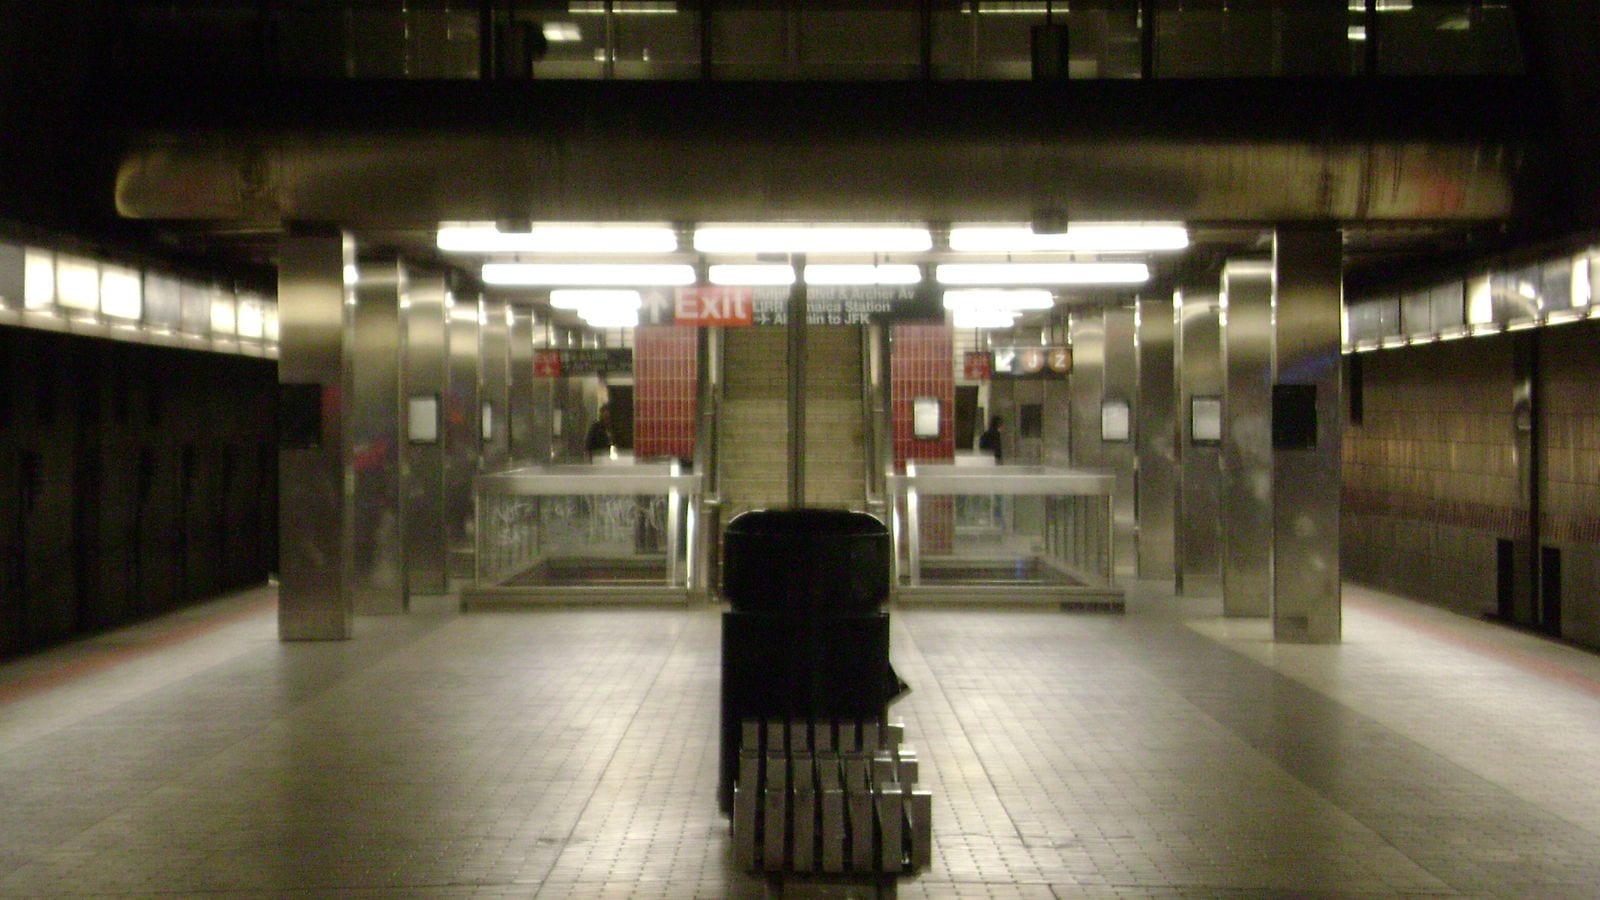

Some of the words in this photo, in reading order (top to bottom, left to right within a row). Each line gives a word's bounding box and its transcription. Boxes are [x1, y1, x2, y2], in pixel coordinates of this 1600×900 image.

[898, 288, 914, 299] Av
[674, 287, 747, 320] Exit
[844, 300, 891, 312] Station
[828, 313, 841, 325] to
[844, 313, 872, 325] JFK
[1054, 354, 1066, 368] Z
